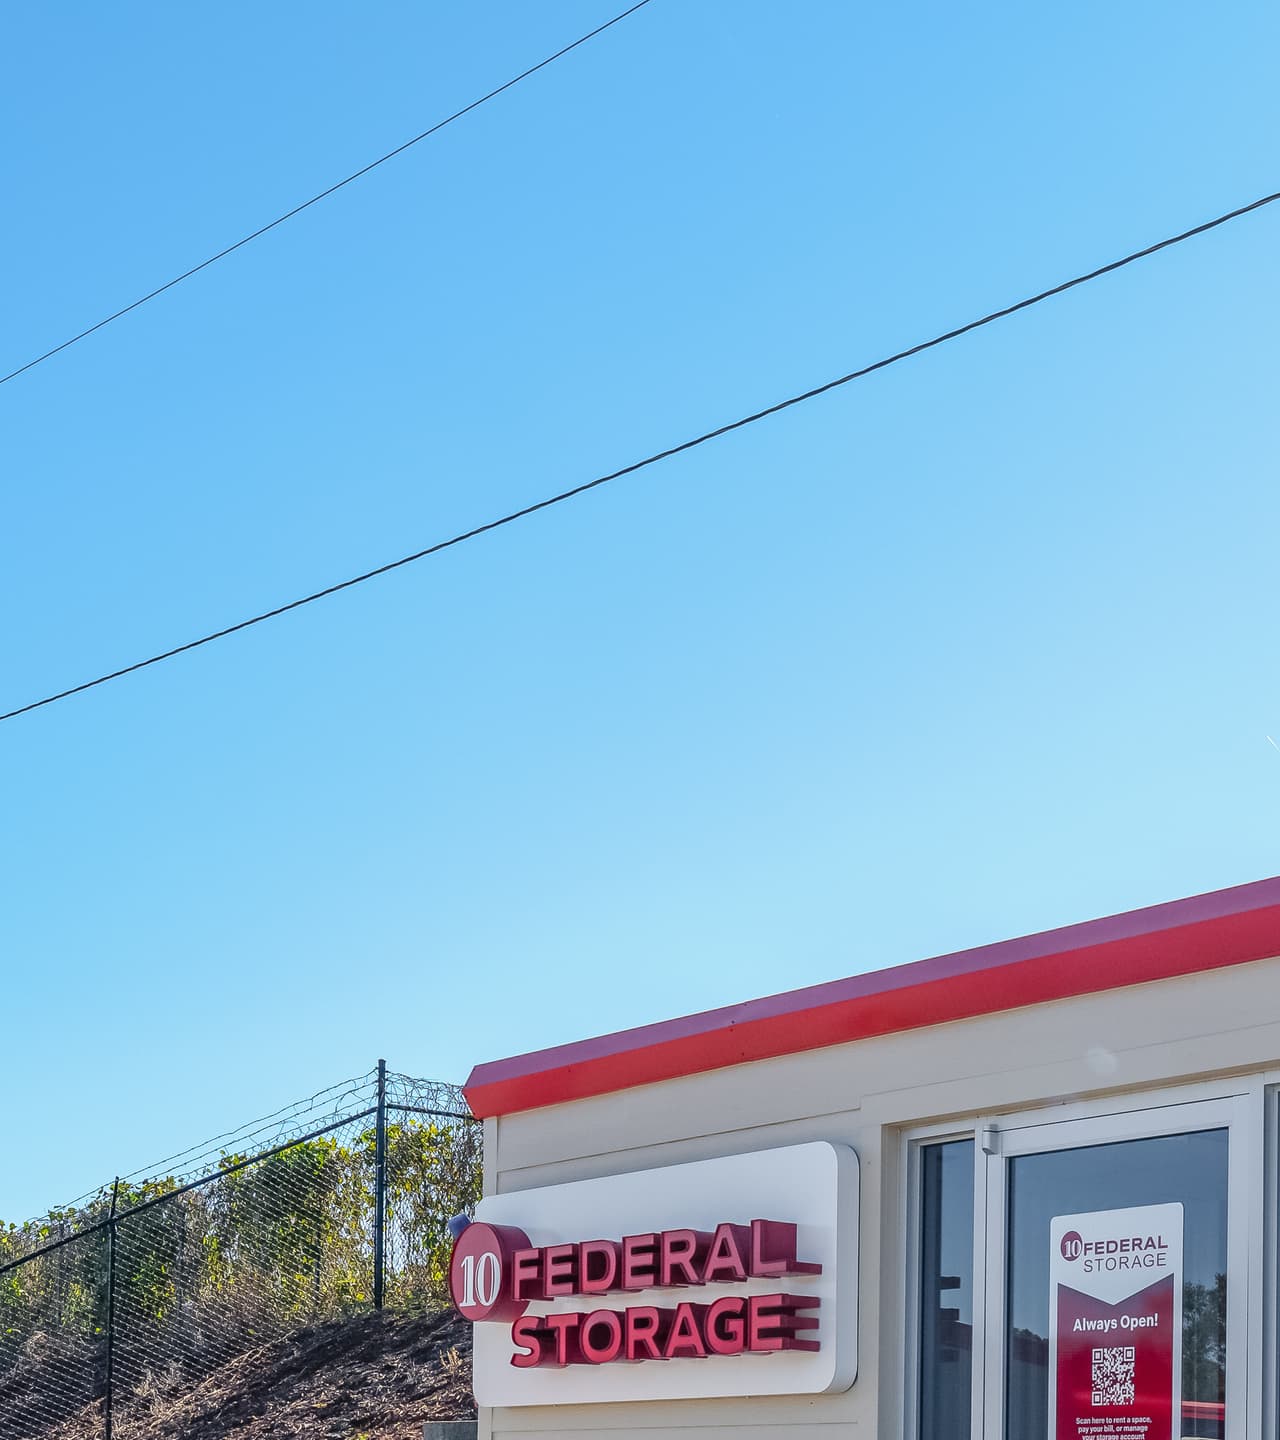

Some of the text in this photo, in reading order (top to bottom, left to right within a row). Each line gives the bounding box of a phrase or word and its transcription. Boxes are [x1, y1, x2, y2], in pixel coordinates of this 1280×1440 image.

[1064, 1235, 1168, 1258] 10 FEDERAL
[459, 1218, 822, 1307] 10 FEDERAL
[1083, 1252, 1167, 1273] STORAGE
[510, 1294, 820, 1369] STORAGE
[1073, 1313, 1158, 1333] Always Open!
[1078, 1426, 1089, 1434] pay
[1090, 1426, 1103, 1434] your
[1123, 1425, 1148, 1433] manage
